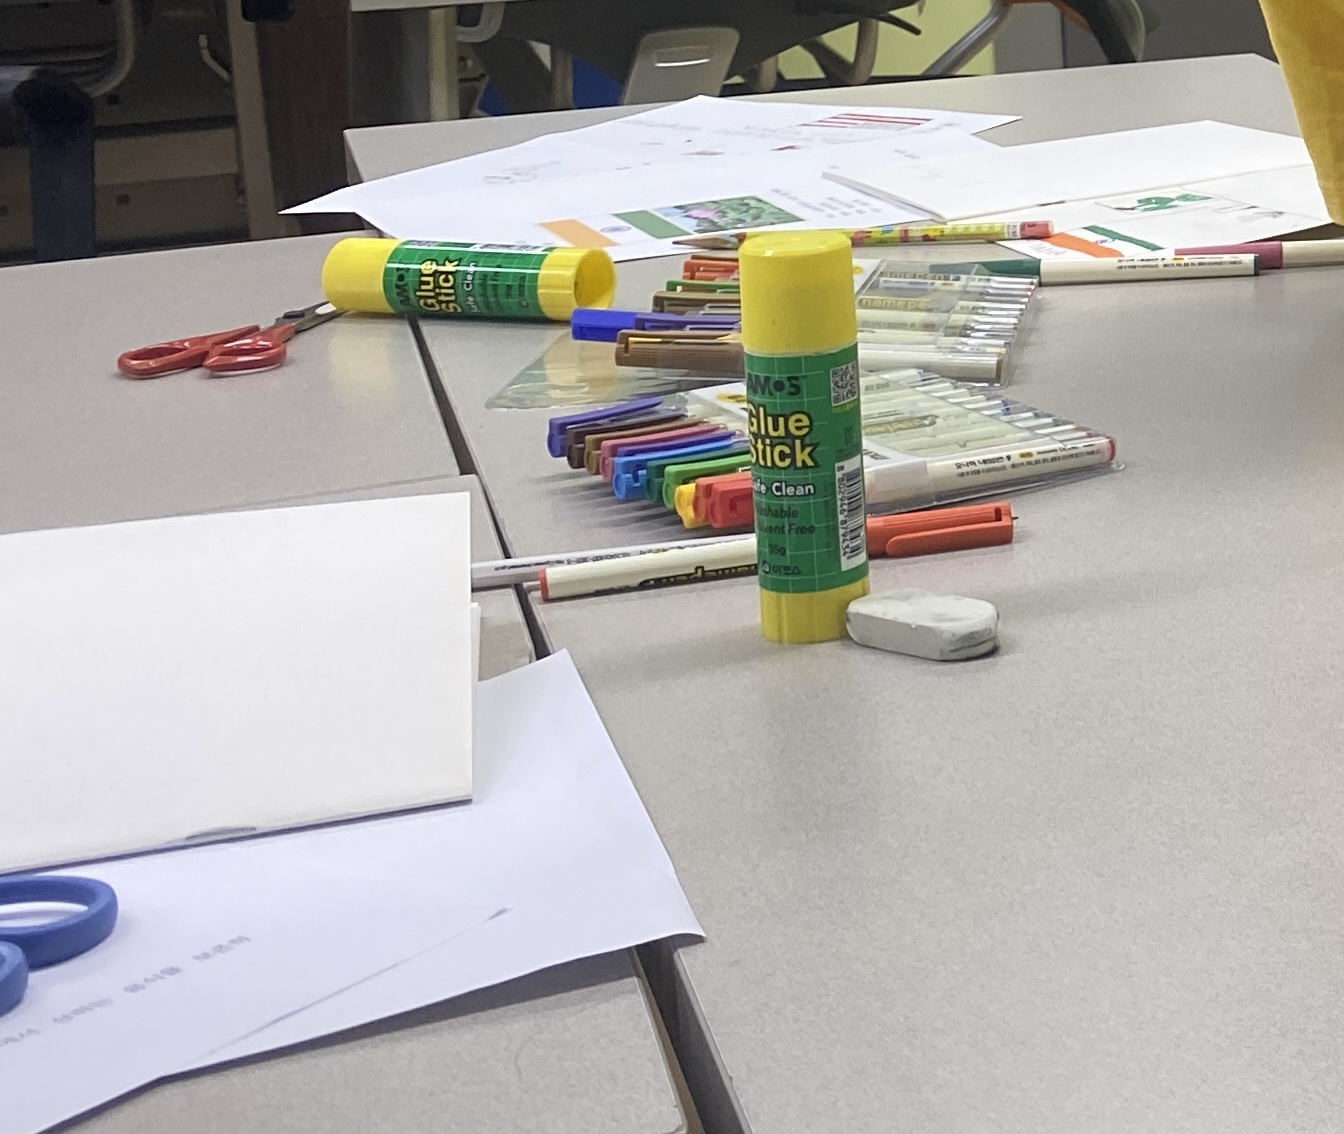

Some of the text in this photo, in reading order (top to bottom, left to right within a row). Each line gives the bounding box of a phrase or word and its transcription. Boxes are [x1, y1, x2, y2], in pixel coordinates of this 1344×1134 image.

[416, 260, 438, 312] Glue
[437, 259, 462, 313] Stick
[748, 403, 811, 438] Glue
[771, 481, 815, 497] Clean
[788, 523, 816, 536] Free
